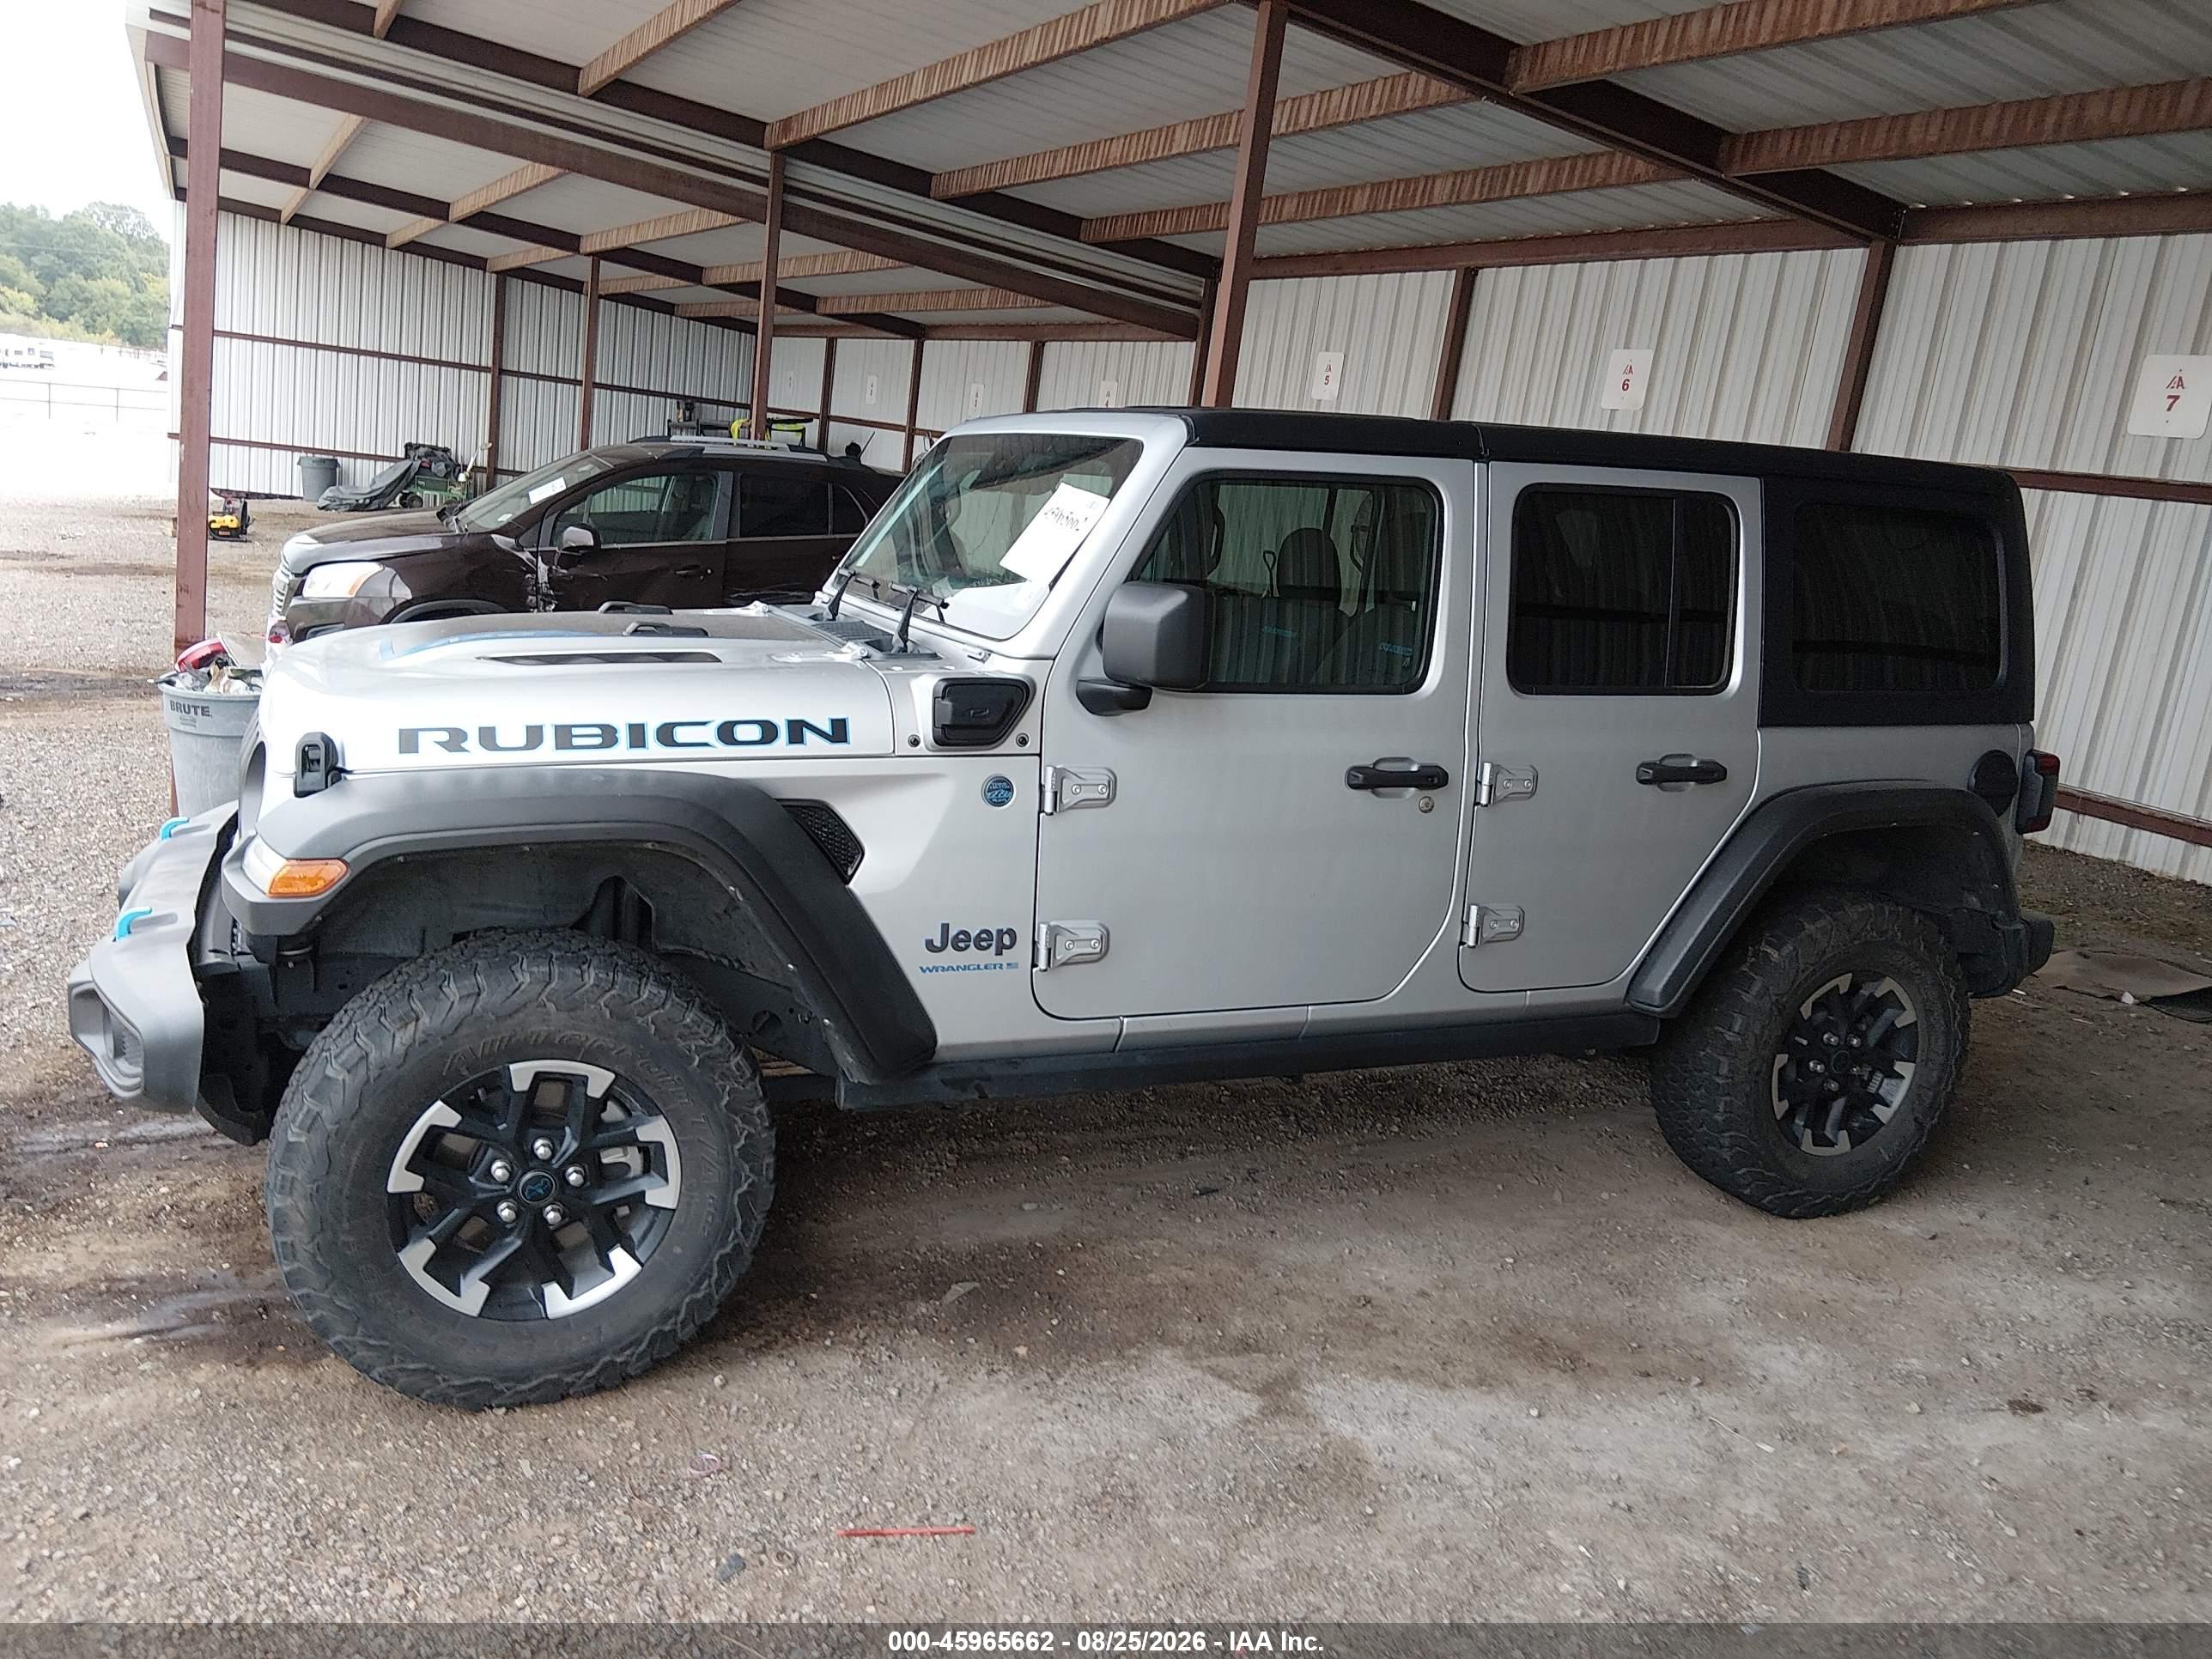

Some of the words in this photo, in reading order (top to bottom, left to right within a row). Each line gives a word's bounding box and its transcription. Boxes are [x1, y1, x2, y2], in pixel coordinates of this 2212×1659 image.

[1324, 375, 1330, 386] 5
[1621, 378, 1631, 392] 6
[2166, 394, 2181, 412] 7
[169, 700, 211, 717] BRUTE
[398, 717, 851, 755] RUBICON
[925, 922, 1018, 956] Jeep
[919, 963, 1004, 973] WRANGLER
